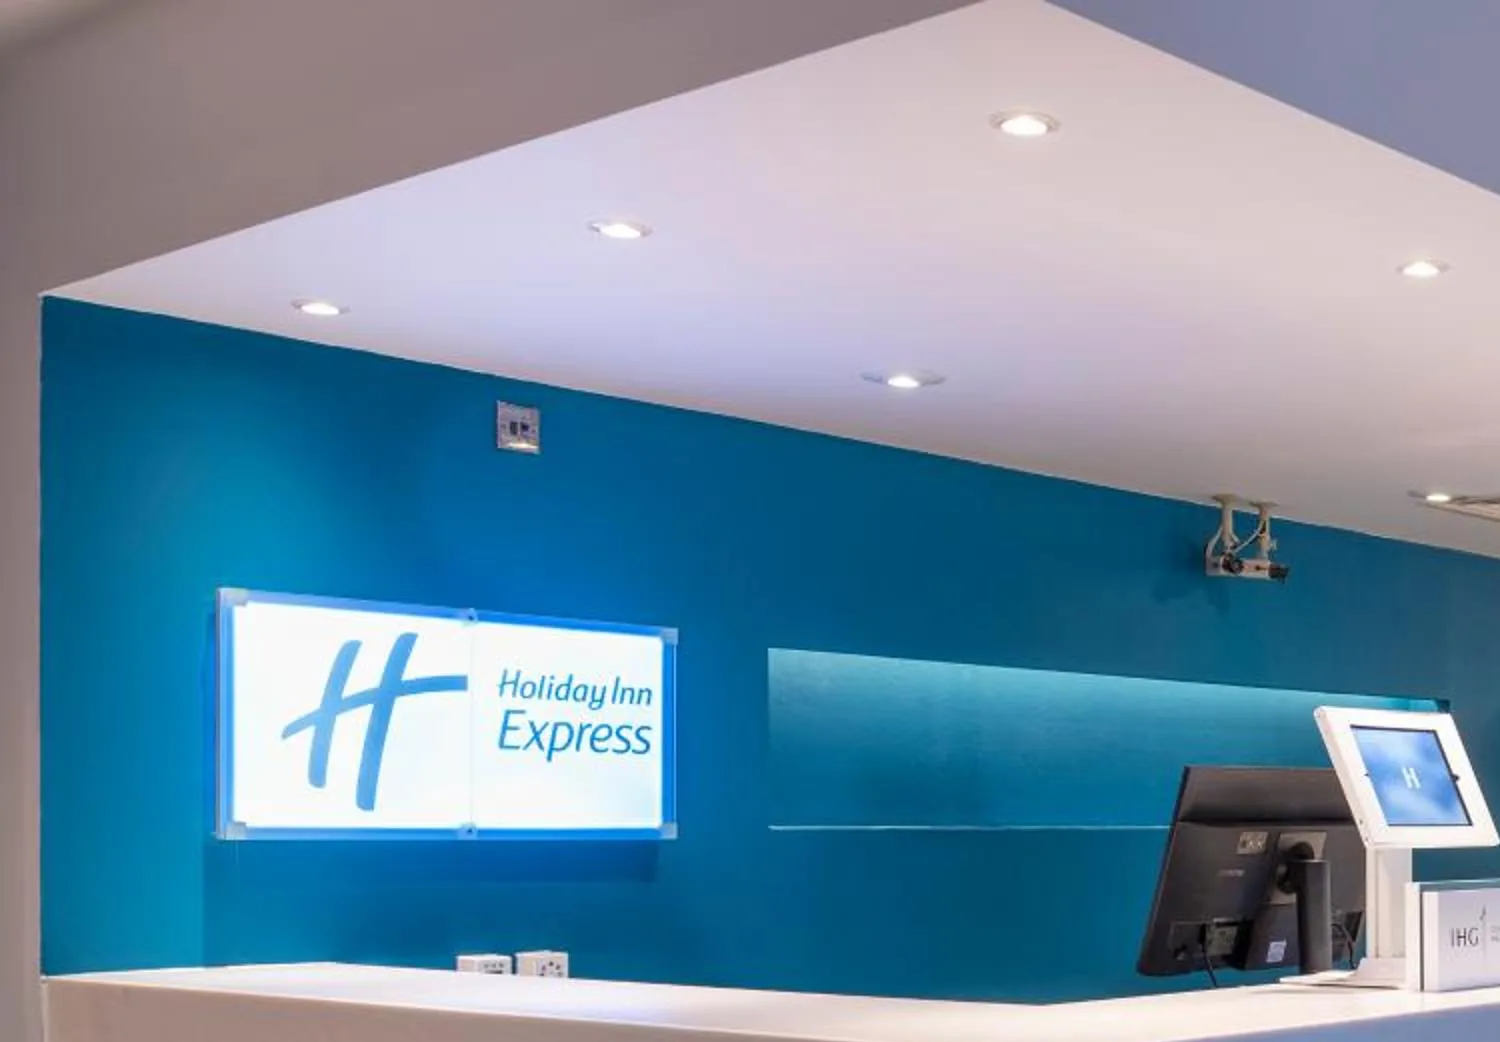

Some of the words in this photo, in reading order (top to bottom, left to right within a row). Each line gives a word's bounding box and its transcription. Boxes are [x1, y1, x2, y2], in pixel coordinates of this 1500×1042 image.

[497, 668, 607, 711] Holiday
[611, 675, 653, 706] Inn
[498, 708, 653, 763] Express
[1449, 926, 1479, 948] IHG
